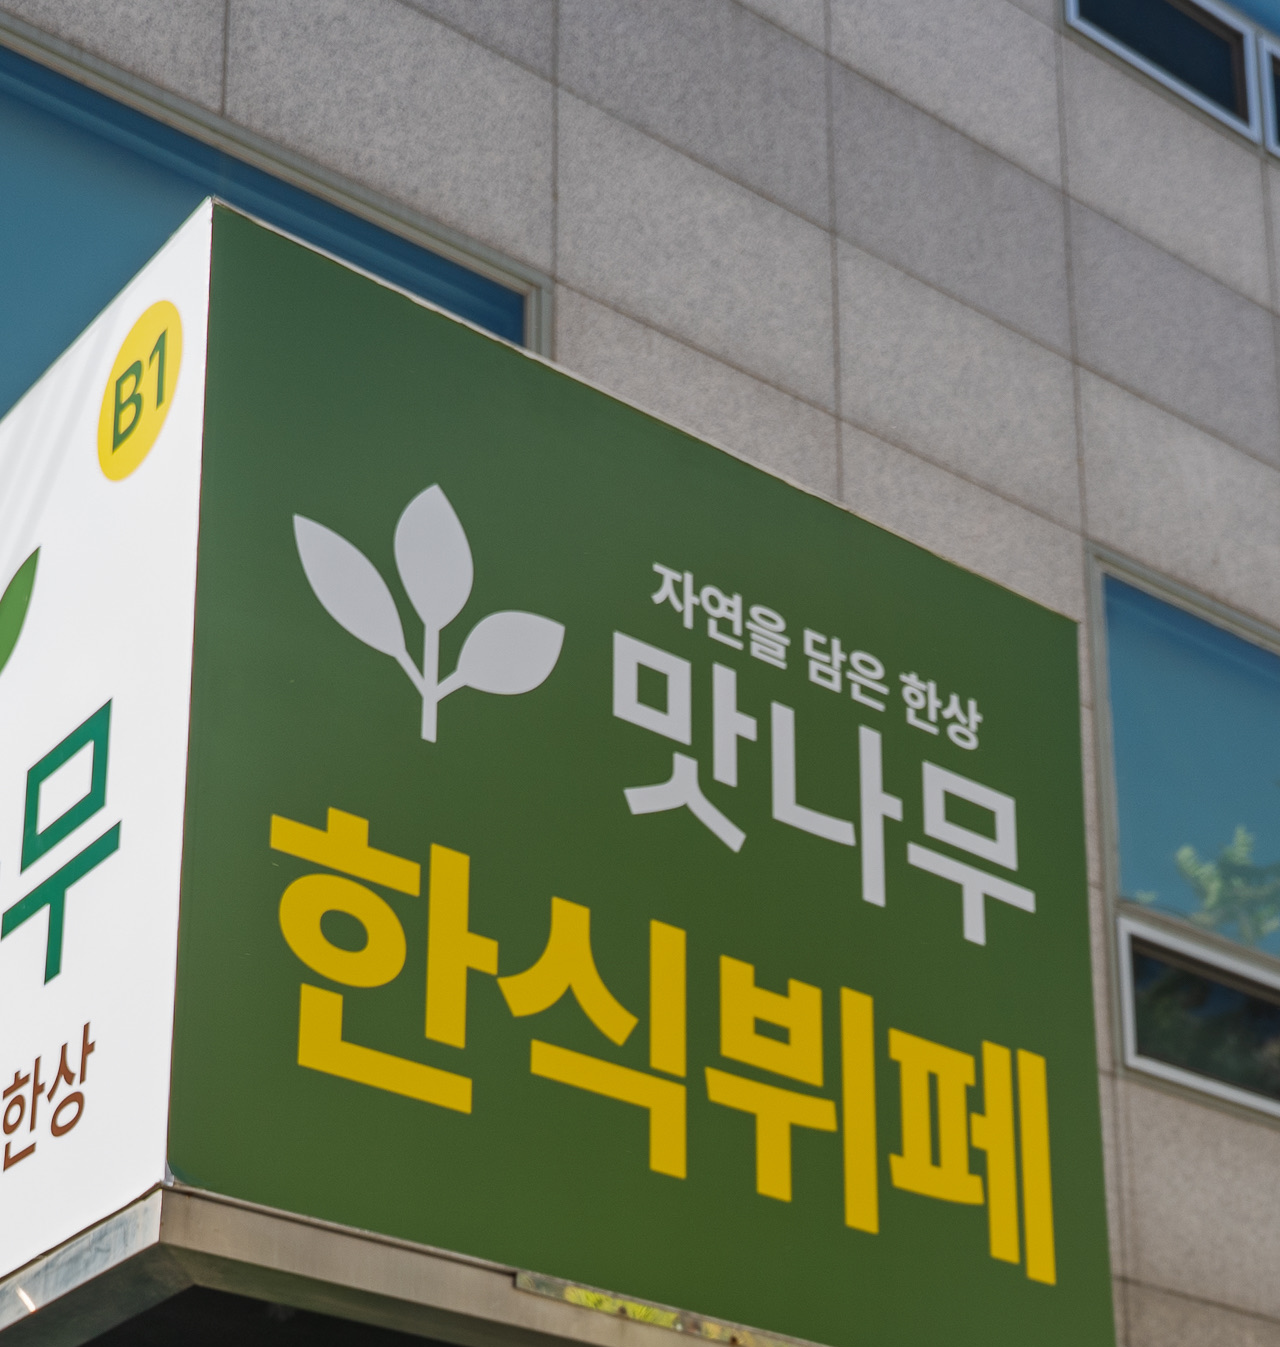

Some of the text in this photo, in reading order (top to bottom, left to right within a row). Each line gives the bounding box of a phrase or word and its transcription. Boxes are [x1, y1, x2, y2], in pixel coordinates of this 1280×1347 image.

[111, 327, 169, 456] B1
[651, 562, 983, 752] 자연을 담은 한상
[612, 630, 1037, 946] 맛나무
[2, 1022, 96, 1172] 한상
[269, 805, 1057, 1286] 한식뷔페
